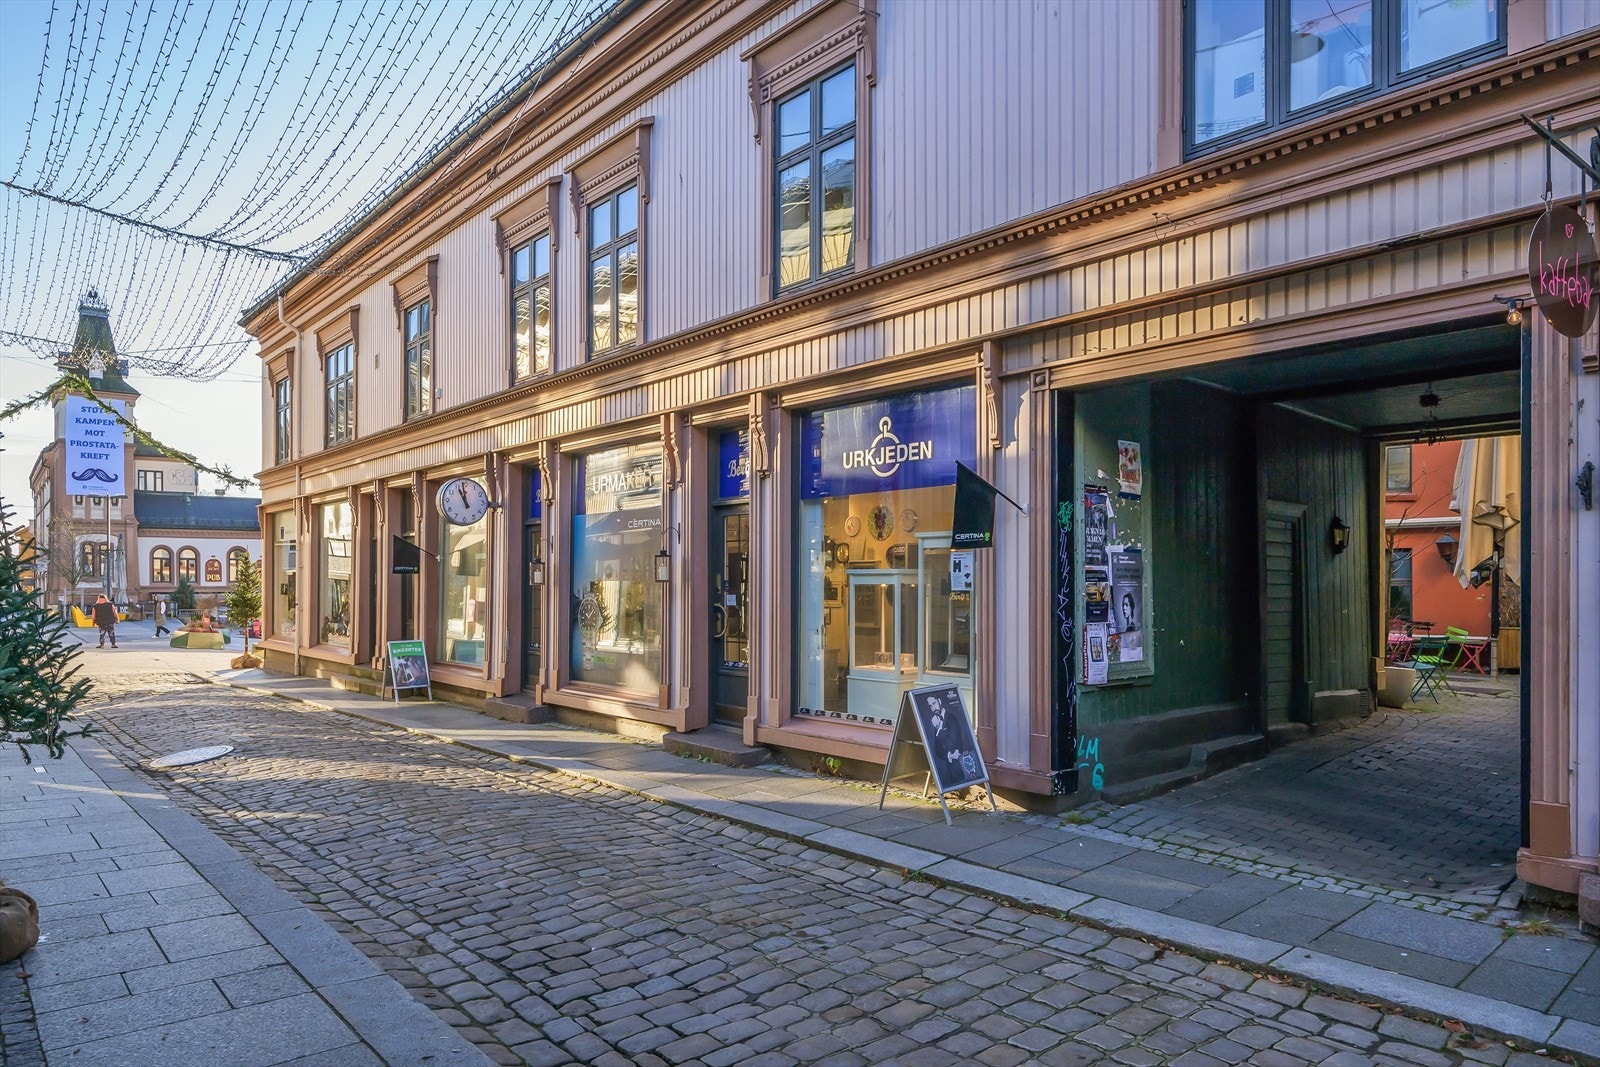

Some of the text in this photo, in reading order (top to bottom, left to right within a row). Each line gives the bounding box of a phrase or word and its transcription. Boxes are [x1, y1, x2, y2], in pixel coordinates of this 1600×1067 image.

[1539, 241, 1594, 310] kaffebar
[81, 406, 106, 414] STØT
[75, 417, 115, 426] KAMPEN
[84, 429, 105, 437] MOT
[70, 440, 119, 449] PROSTATA-
[80, 452, 110, 460] KREFT
[843, 440, 932, 469] URKJEDEN
[592, 469, 652, 494] URMAKER
[627, 518, 662, 528] CERTINA
[954, 532, 984, 540] CERTINA
[206, 573, 221, 581] PUB
